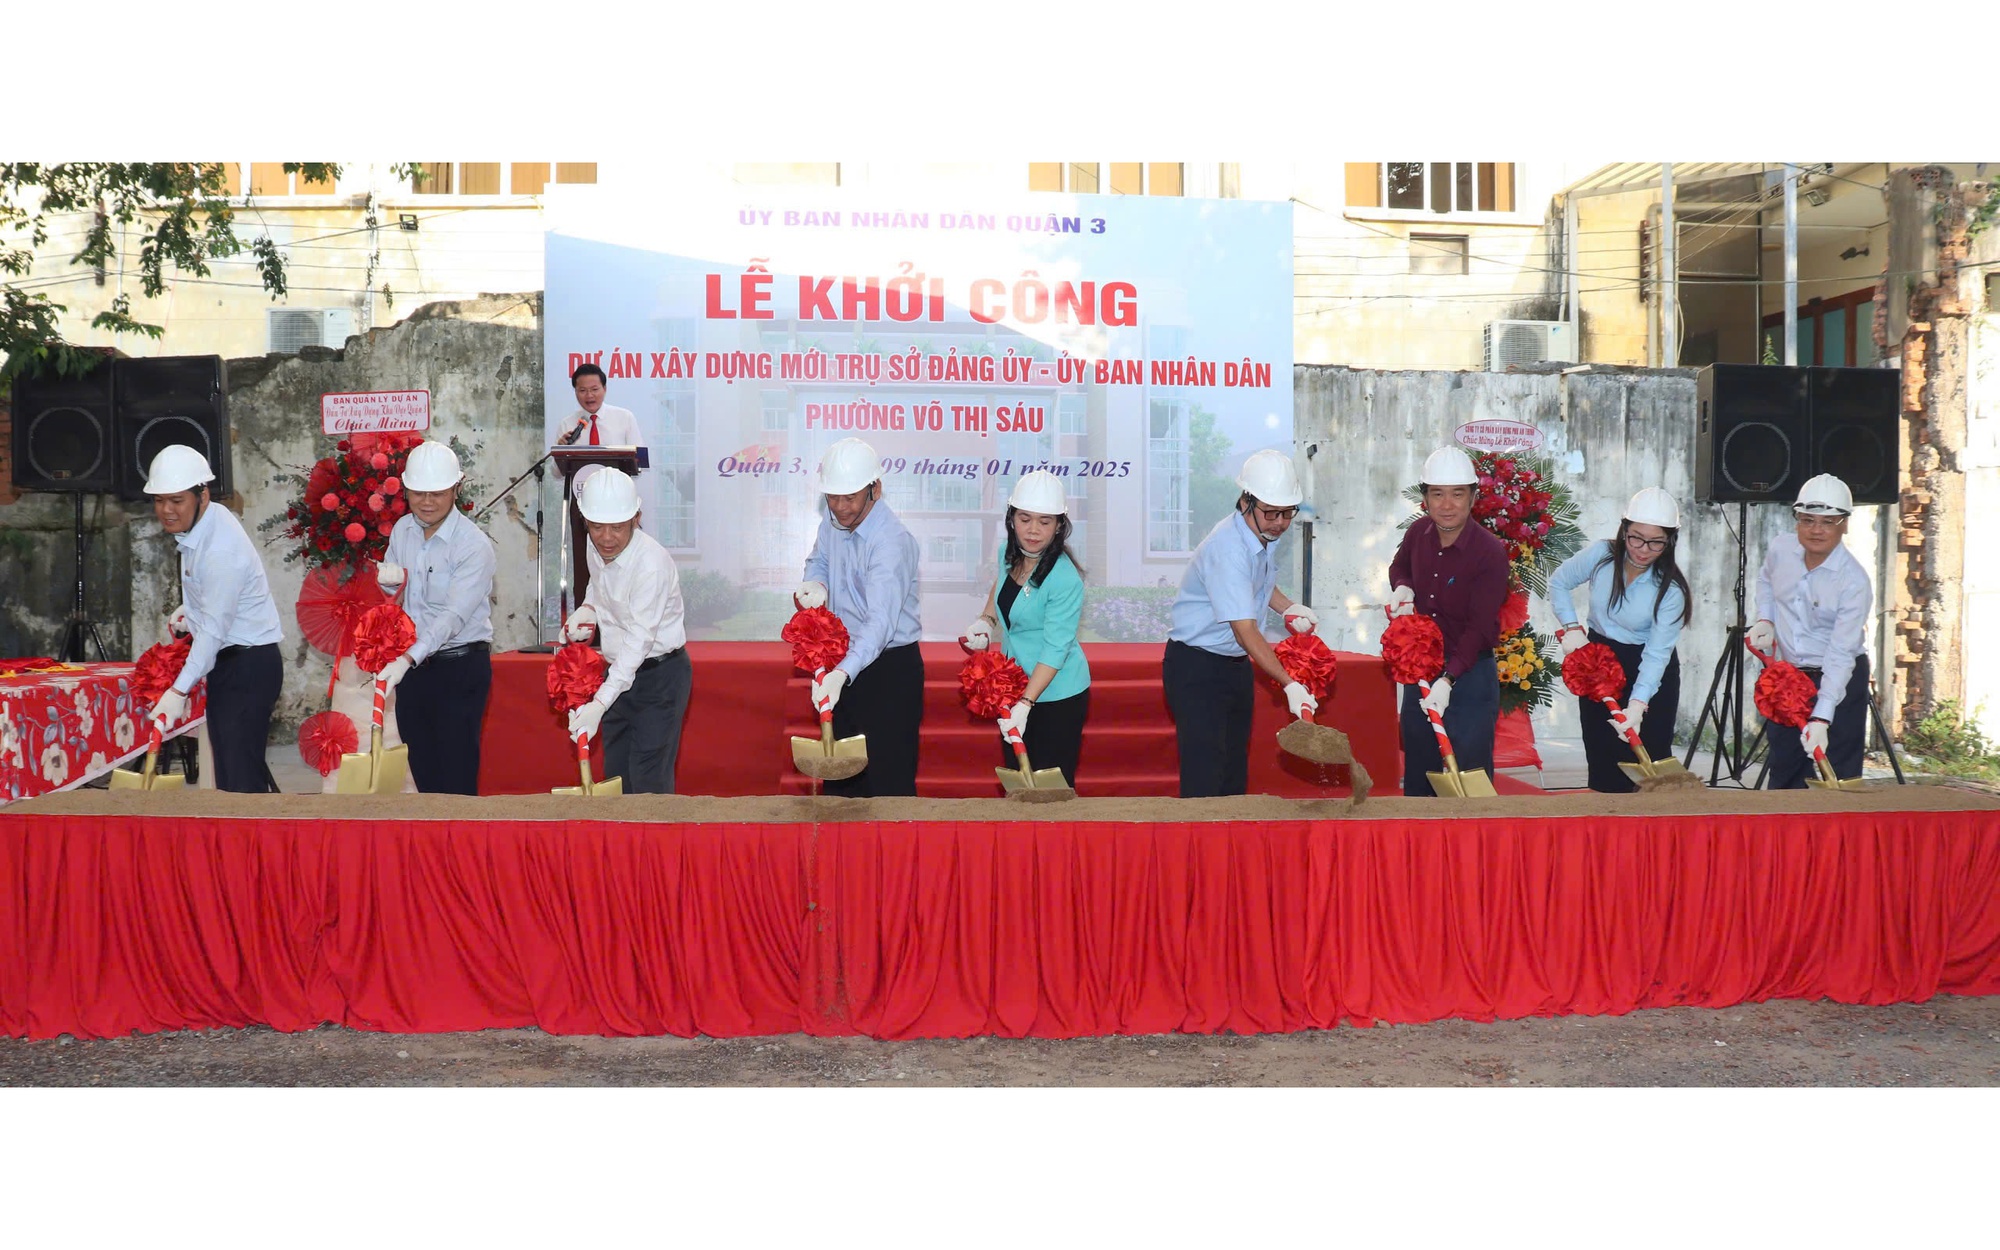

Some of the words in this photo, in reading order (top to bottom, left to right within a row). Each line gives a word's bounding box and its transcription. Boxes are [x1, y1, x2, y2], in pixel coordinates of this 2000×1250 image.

[739, 204, 773, 226] ỦY
[784, 210, 841, 227] BAN
[851, 208, 930, 229] NHÂN
[940, 209, 996, 231] DÂN
[1007, 213, 1081, 237] QUẬN
[1090, 217, 1107, 235] 3
[705, 256, 775, 320] LỄ
[799, 261, 945, 323] KHỞI
[969, 269, 1138, 327] CÔNG
[608, 347, 642, 379] ÁN
[650, 346, 698, 379] XÂY
[705, 350, 773, 385] DỰNG
[780, 347, 828, 380] MỚI
[836, 353, 881, 386] TRỤ
[888, 346, 922, 381] SỞ
[928, 347, 994, 382] ĐẢNG
[1002, 348, 1033, 382] ỦY
[1057, 349, 1087, 384] ỦY
[1095, 358, 1143, 385] BAN
[1151, 355, 1216, 387] NHÂN
[1223, 357, 1272, 388] DÂN
[333, 397, 350, 405] BAN
[806, 397, 905, 431] PHƯỜNG
[912, 400, 943, 431] VÕ
[951, 404, 988, 438] THỊ
[995, 401, 1044, 433] SÁU
[334, 418, 371, 431] Chúc
[376, 417, 417, 430] Mừng
[717, 456, 782, 478] Quận
[788, 457, 808, 476] 3,
[912, 458, 979, 480] tháng
[987, 458, 1012, 476] 01
[1020, 459, 1070, 477] năm
[1077, 460, 1131, 478] 2025
